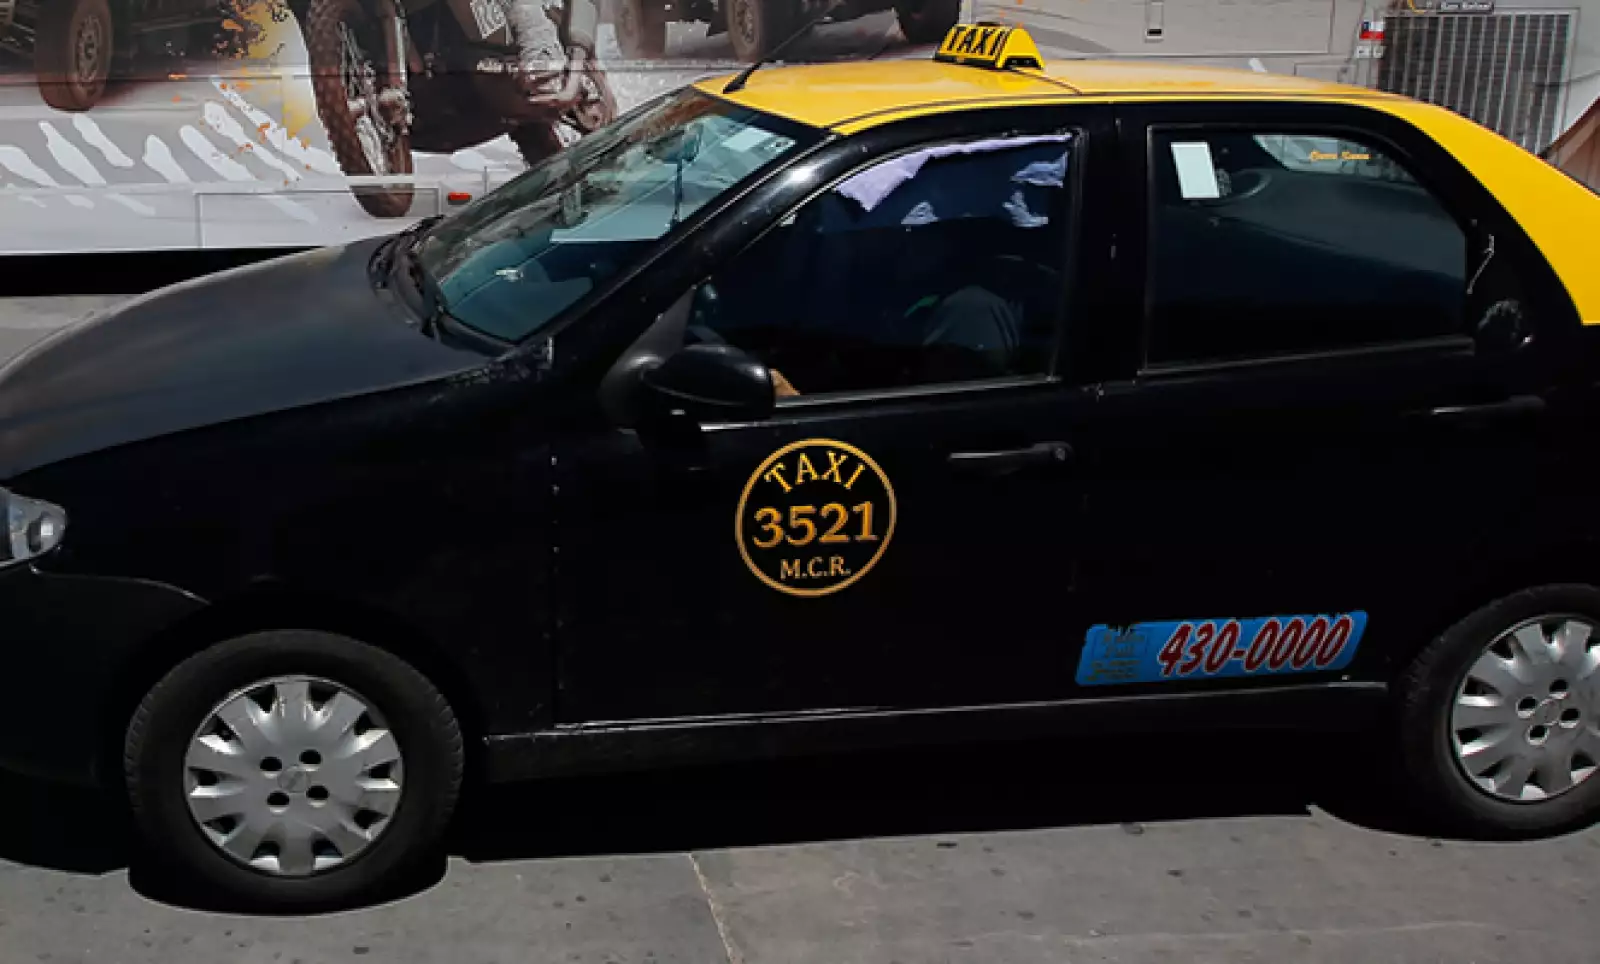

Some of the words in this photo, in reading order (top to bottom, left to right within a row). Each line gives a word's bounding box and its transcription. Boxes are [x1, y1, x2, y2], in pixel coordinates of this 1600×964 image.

[944, 25, 1007, 57] TAXI
[764, 450, 866, 493] TAXI
[753, 501, 879, 548] 3521
[779, 555, 852, 580] M.C.R.
[1157, 614, 1354, 679] 430-0000
